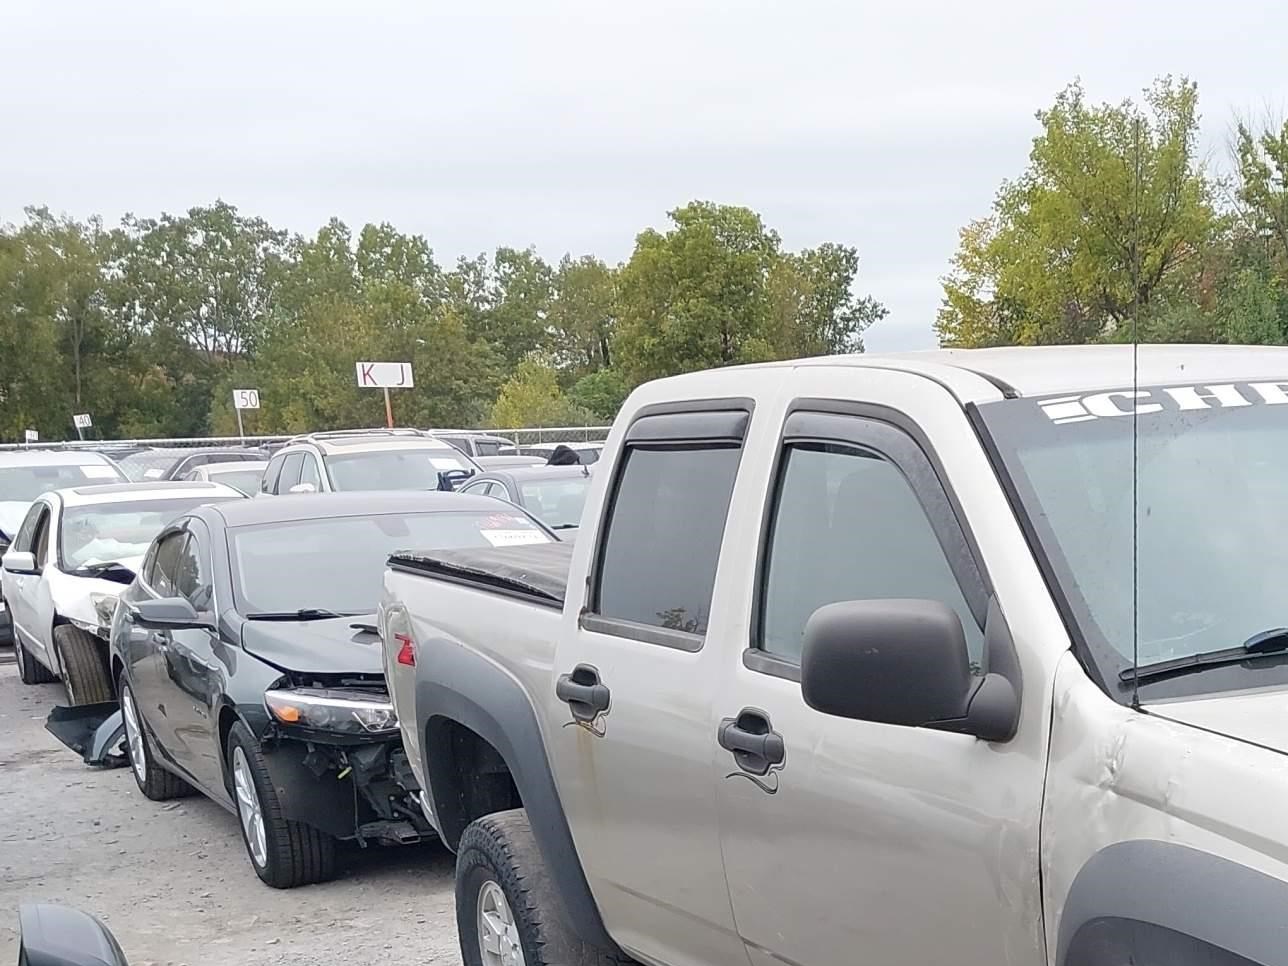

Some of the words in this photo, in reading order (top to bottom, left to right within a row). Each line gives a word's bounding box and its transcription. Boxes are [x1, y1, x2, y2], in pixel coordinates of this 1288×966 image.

[361, 364, 377, 386] K
[397, 364, 404, 386] J
[241, 391, 258, 408] 50
